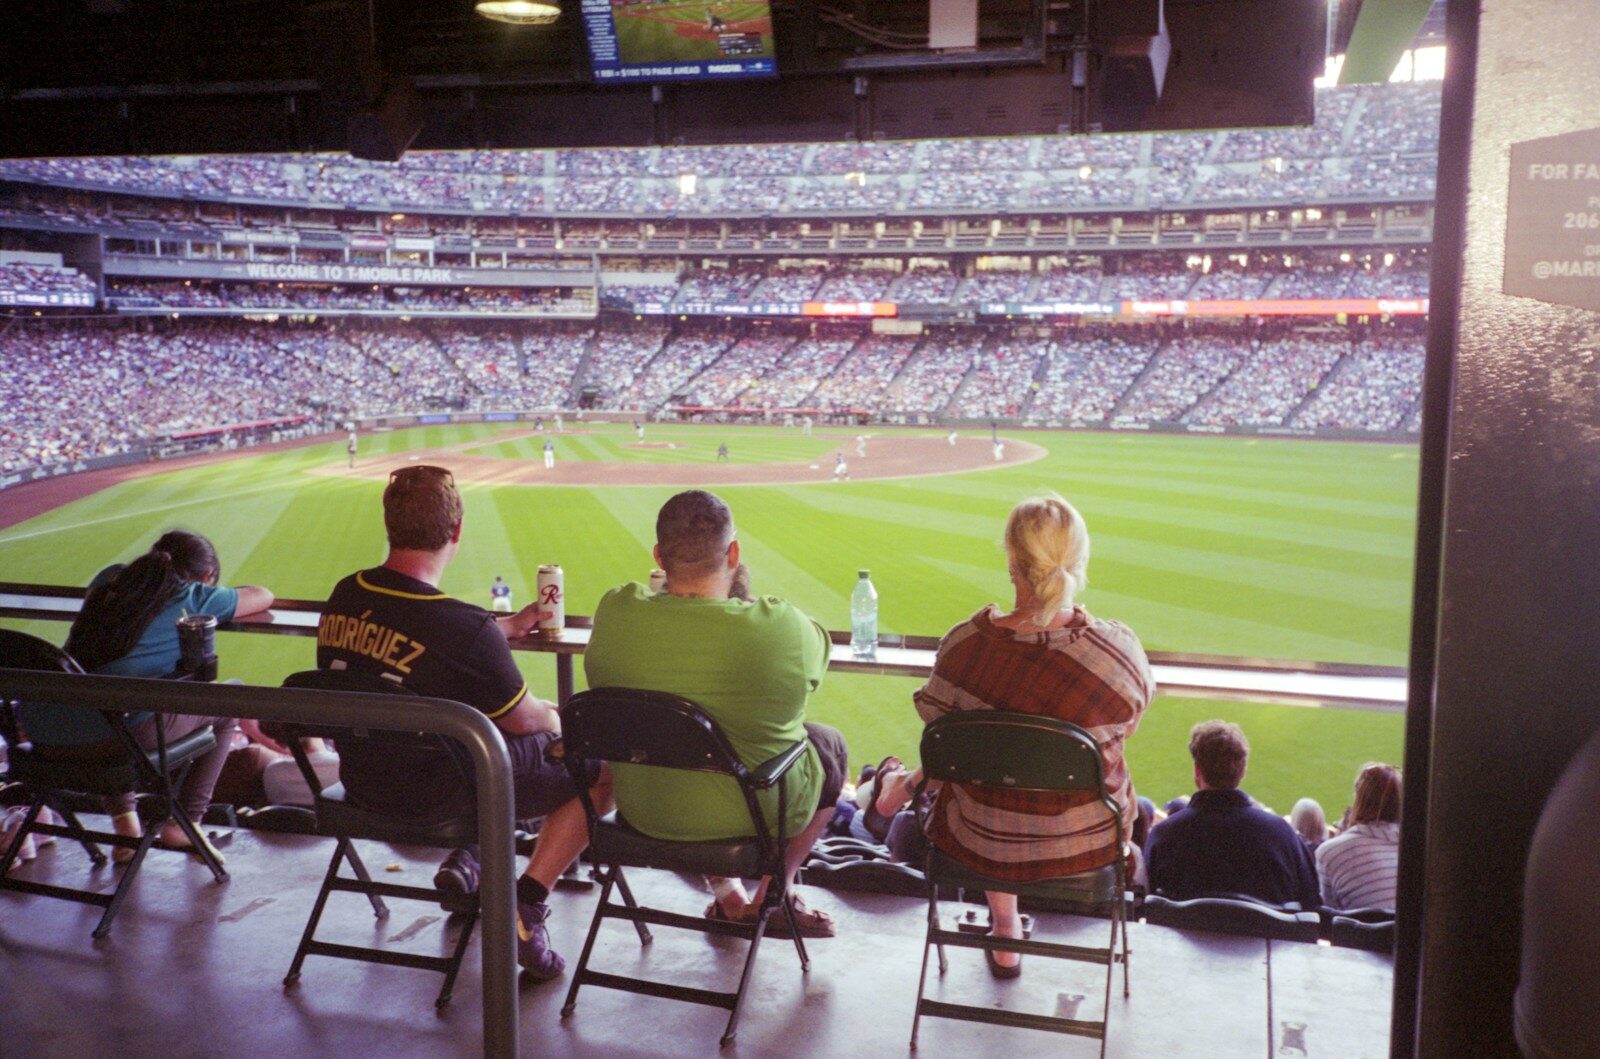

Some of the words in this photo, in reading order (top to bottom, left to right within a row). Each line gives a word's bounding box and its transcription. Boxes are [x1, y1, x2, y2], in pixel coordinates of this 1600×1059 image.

[1528, 164, 1568, 180] FOR
[1563, 212, 1600, 229] 206
[247, 263, 319, 279] WELCOME
[324, 266, 342, 280] TO
[349, 266, 411, 281] T-MOBILE
[414, 268, 452, 283] PARK
[317, 610, 427, 674] RODRÍGUEZ
